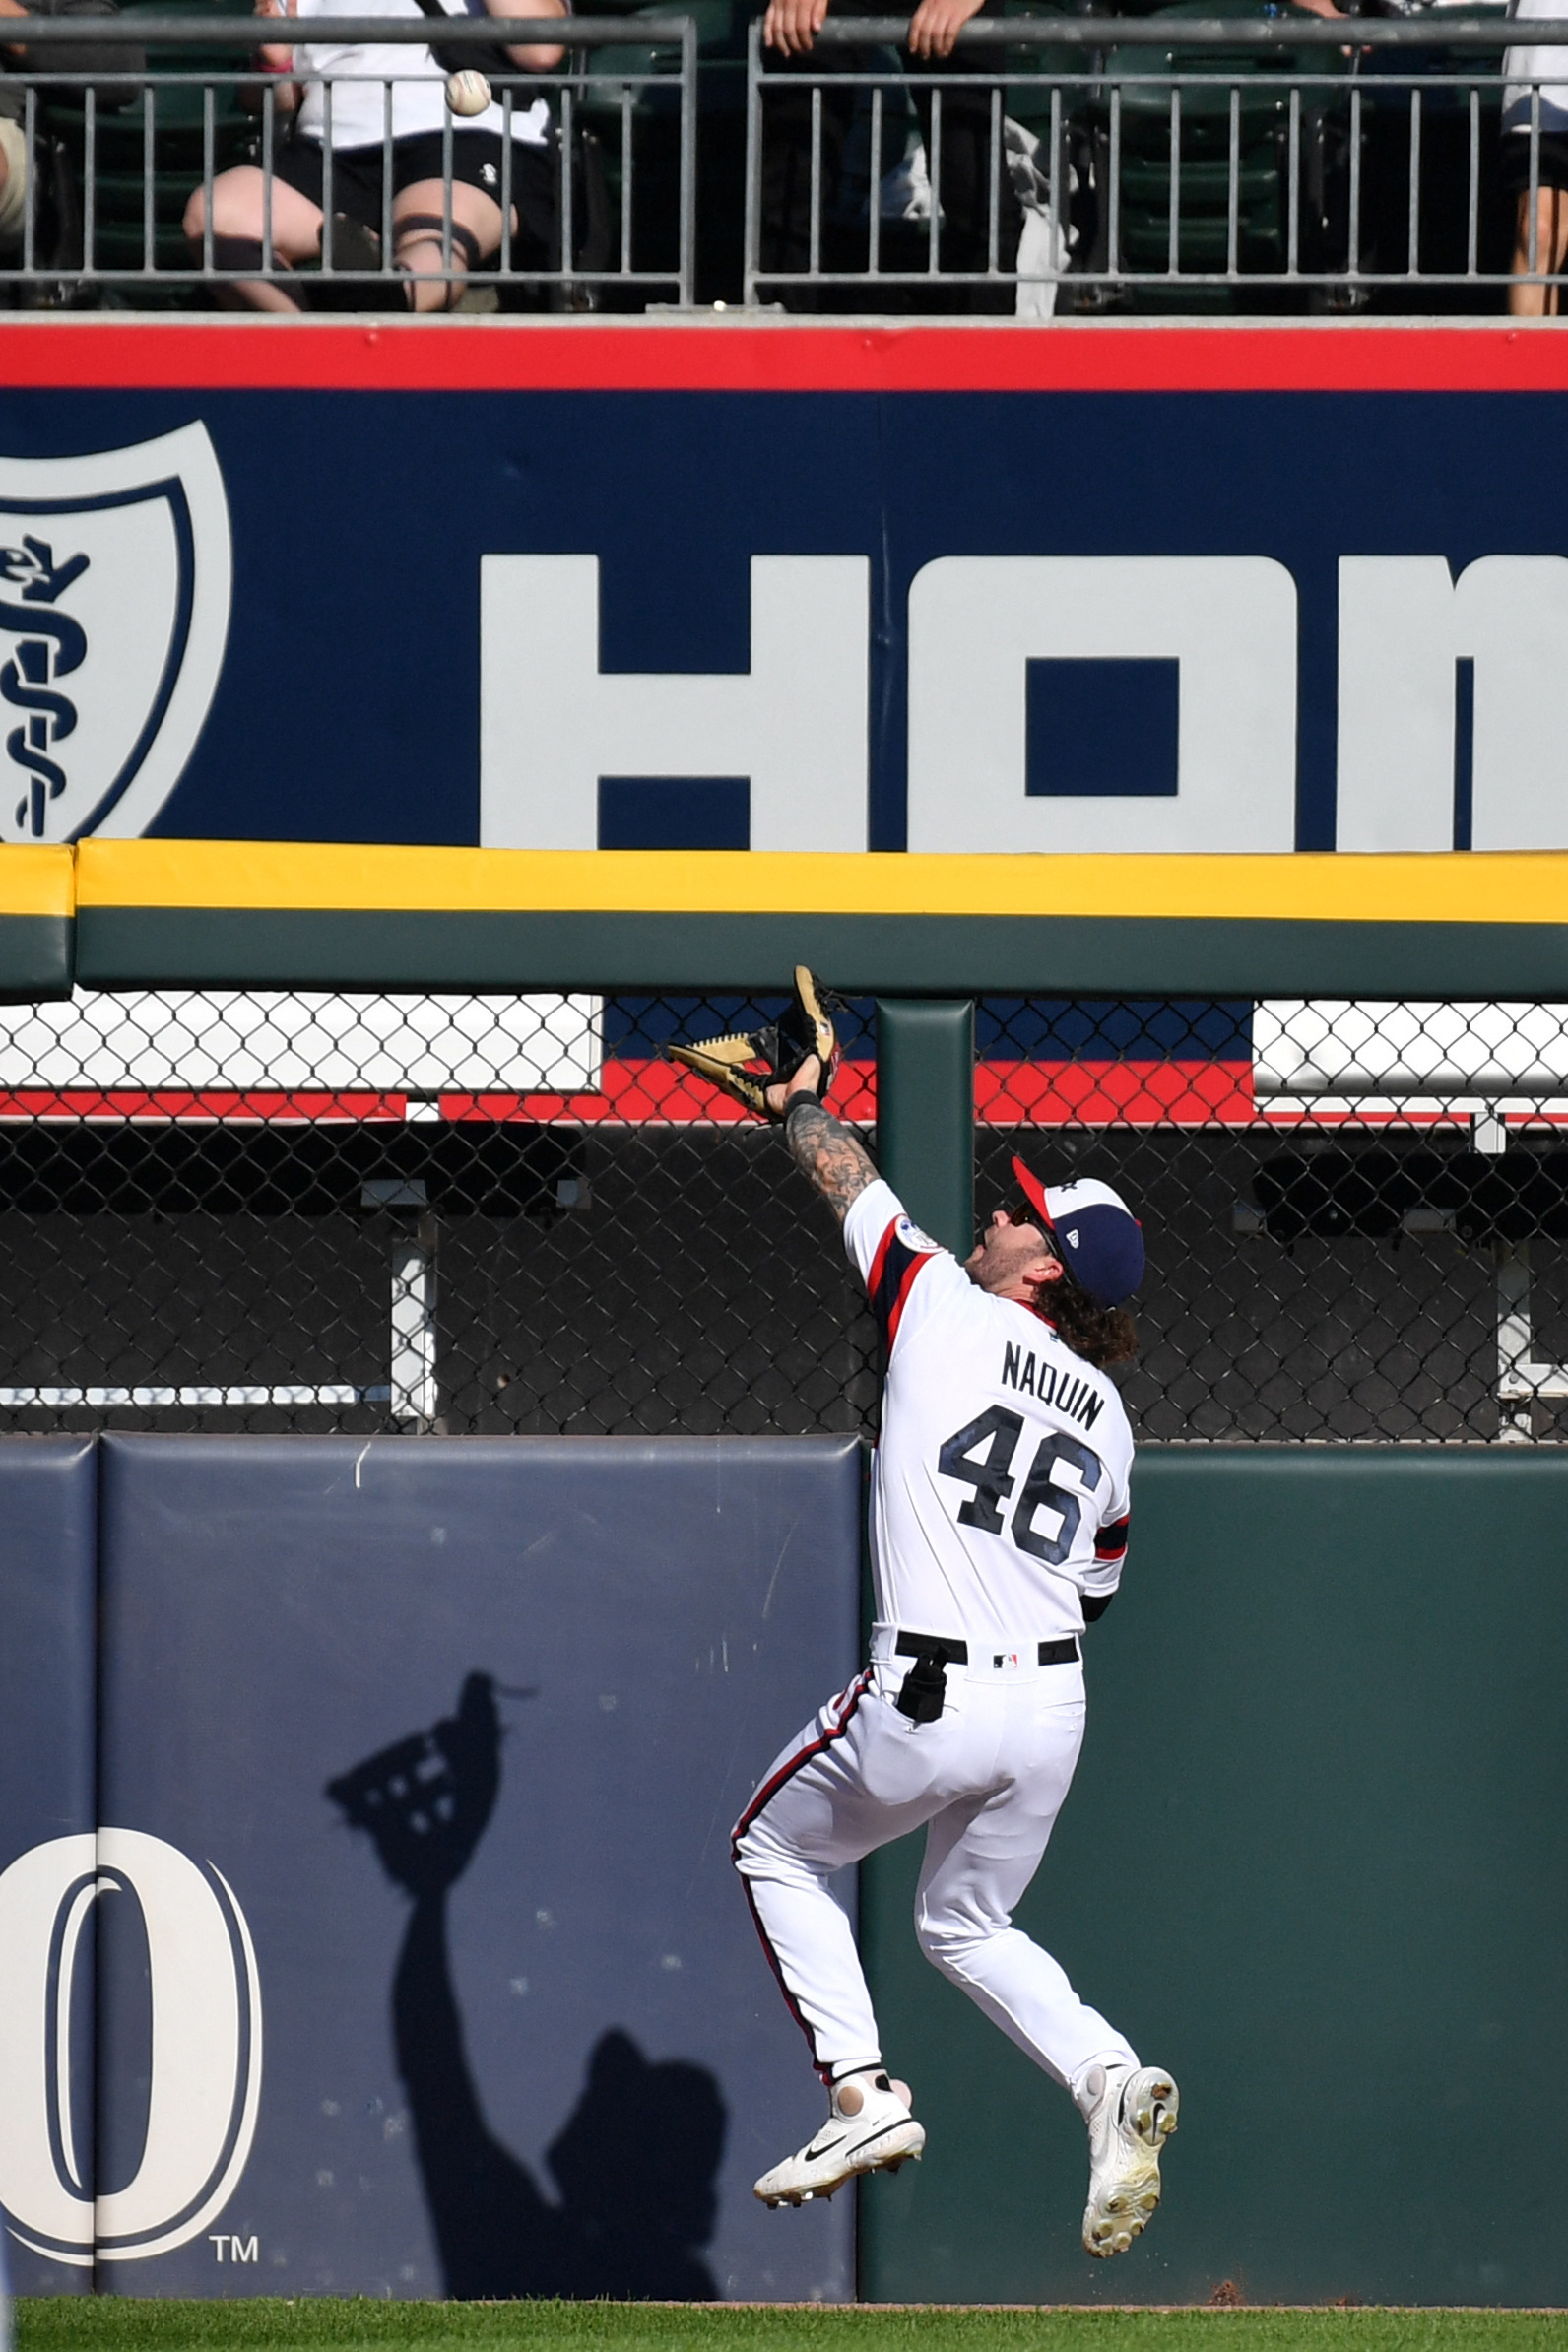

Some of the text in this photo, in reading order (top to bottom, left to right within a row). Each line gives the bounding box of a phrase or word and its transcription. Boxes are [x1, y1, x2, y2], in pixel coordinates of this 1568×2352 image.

[1002, 1340, 1106, 1433] NAQUIN
[938, 1404, 1102, 1567] 46
[208, 2234, 260, 2264] TM
